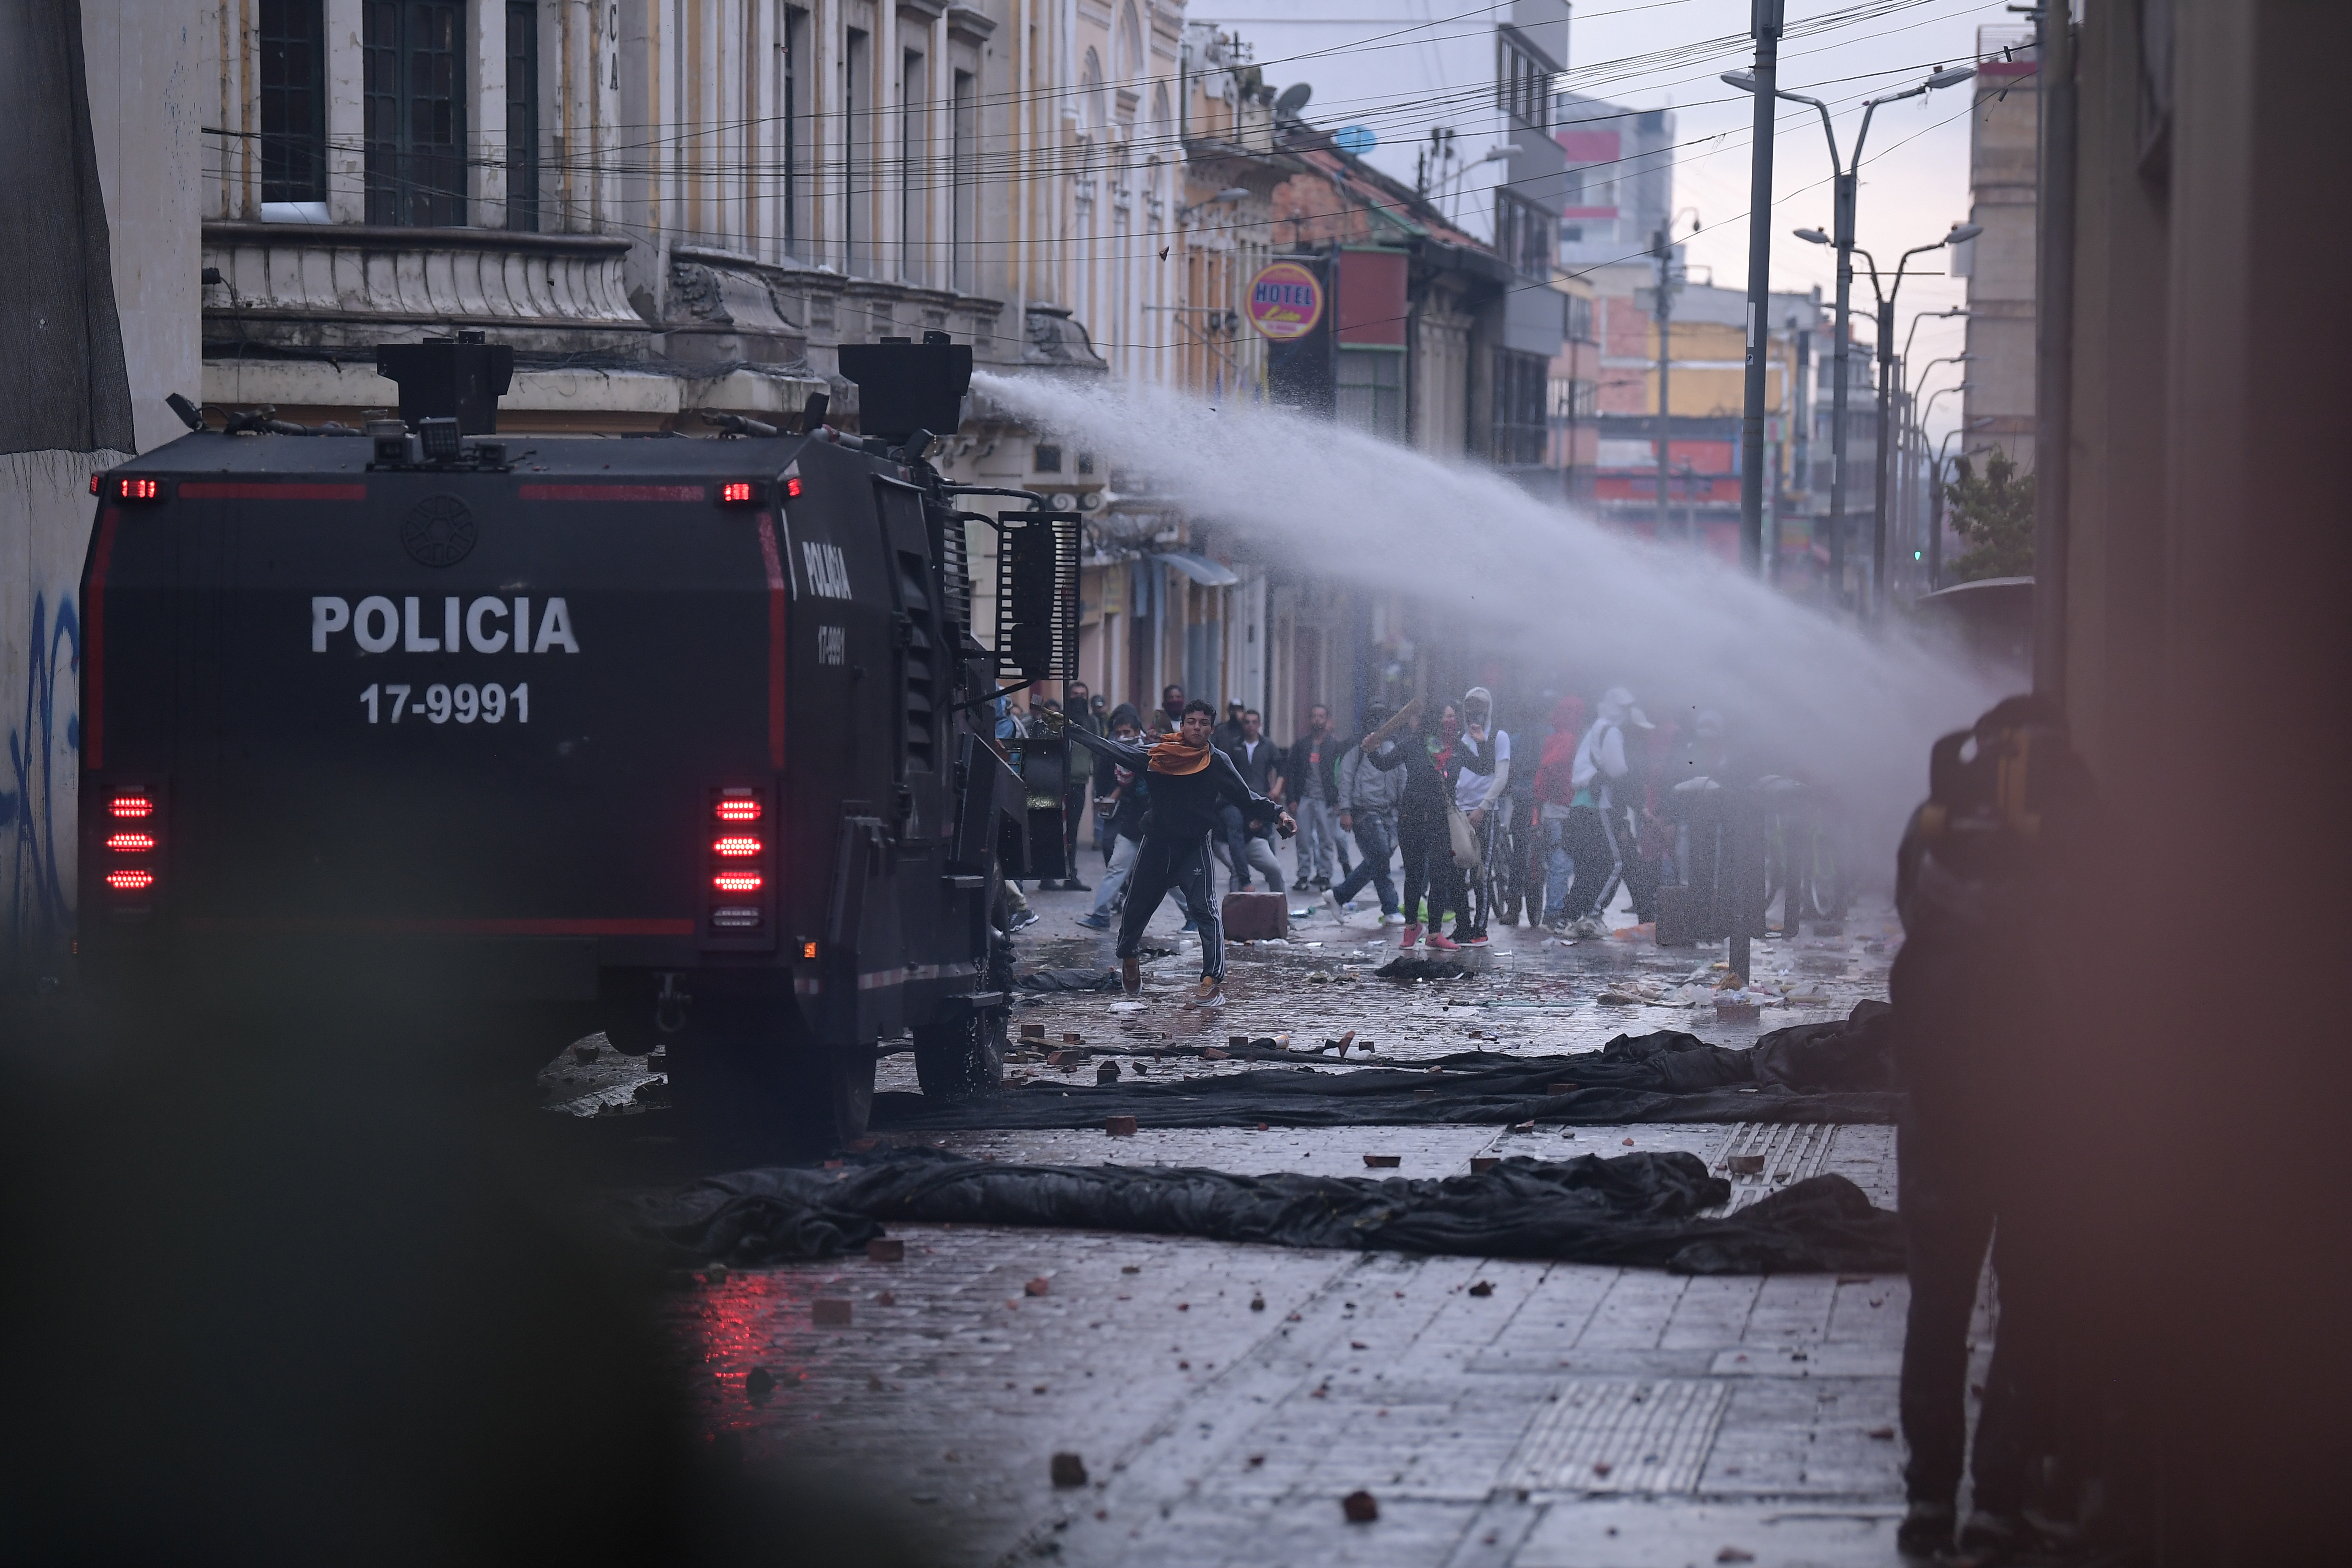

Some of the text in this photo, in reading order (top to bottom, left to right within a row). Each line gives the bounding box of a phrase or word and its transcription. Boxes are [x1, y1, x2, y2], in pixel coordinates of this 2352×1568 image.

[1256, 282, 1312, 306] HOTEL
[802, 541, 852, 600] POLICIA
[312, 596, 580, 653] POLICIA
[360, 682, 528, 724] 17-9991
